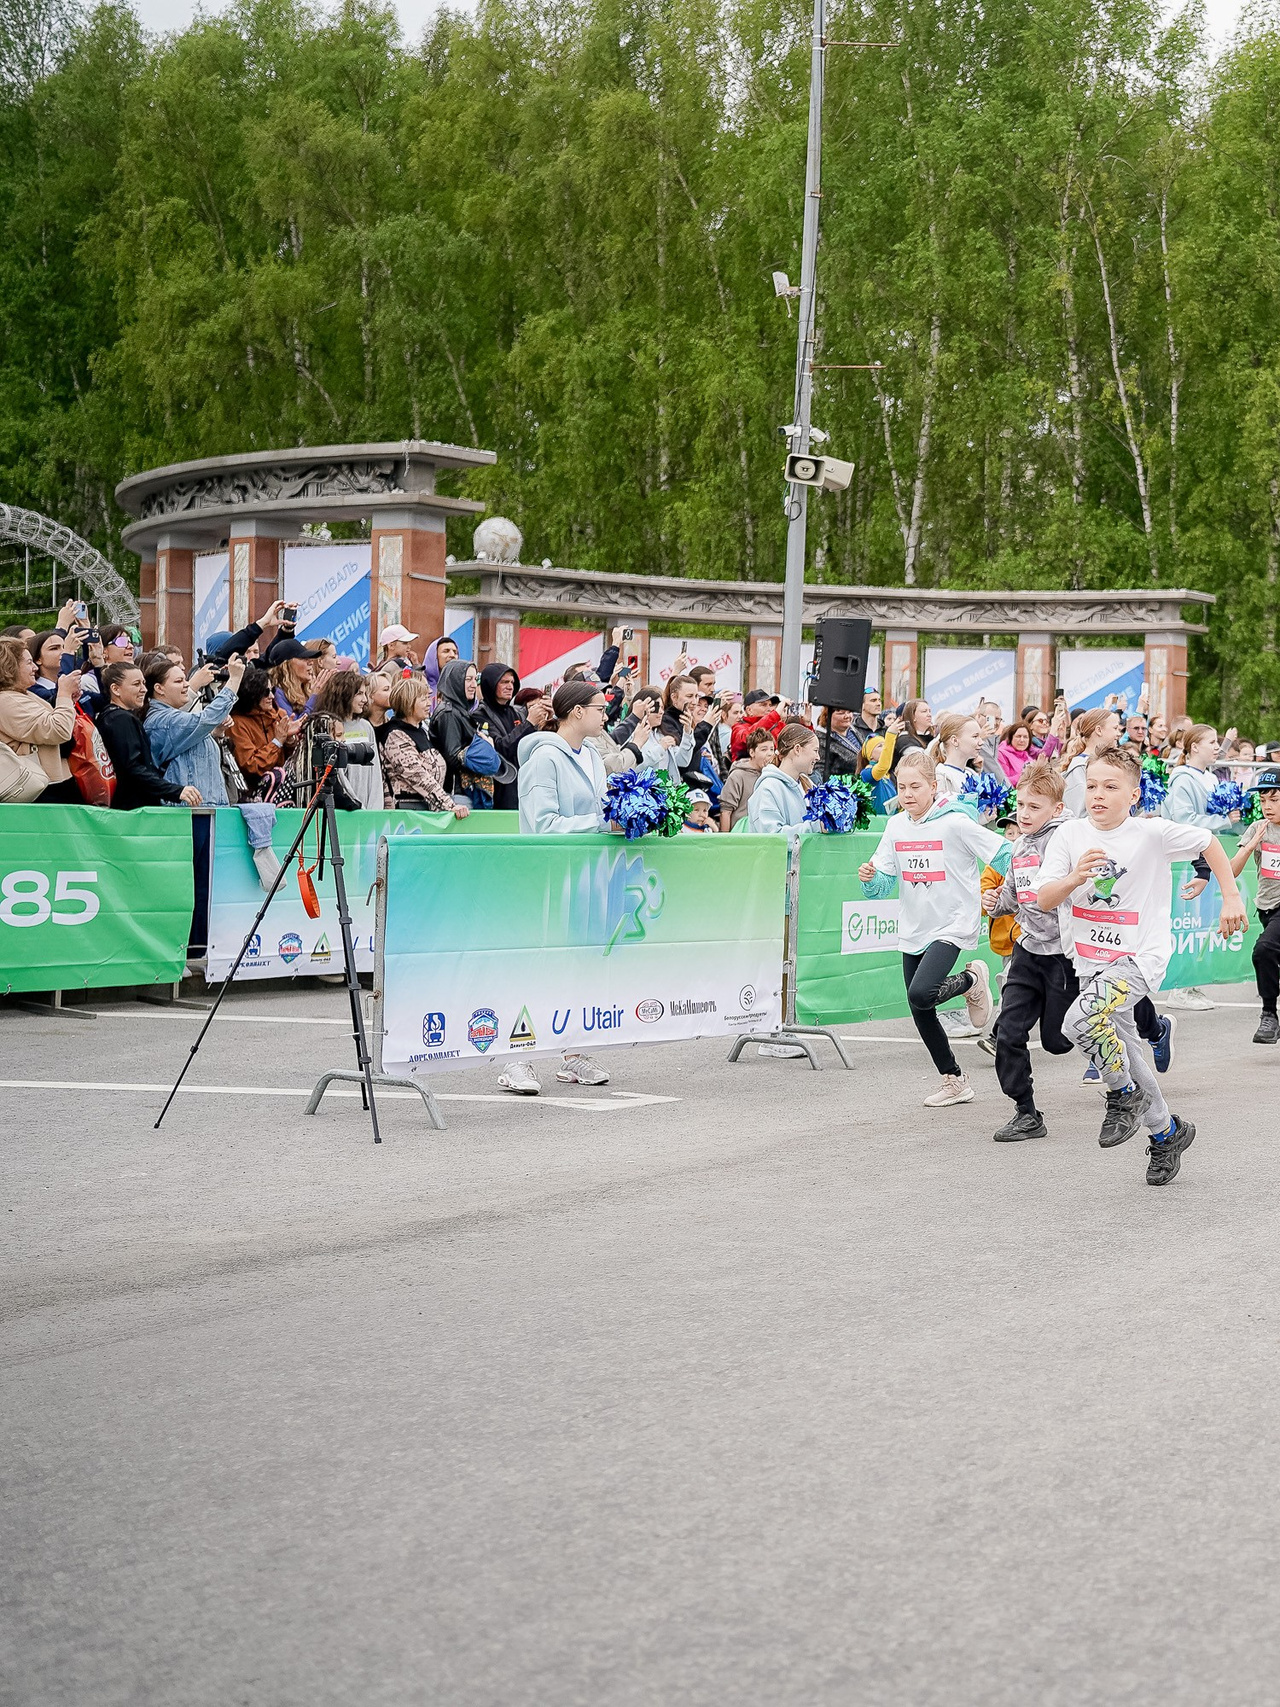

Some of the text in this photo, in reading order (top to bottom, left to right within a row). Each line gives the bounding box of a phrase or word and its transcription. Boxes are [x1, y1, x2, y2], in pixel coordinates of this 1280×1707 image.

[907, 858, 930, 869] 2761
[0, 870, 101, 928] 85
[866, 915, 898, 939] Пра
[1171, 912, 1202, 930] оём
[1090, 929, 1122, 946] 2646
[582, 1004, 625, 1032] Utair
[408, 1050, 461, 1063] ДОРКОМПЛЕКТ
